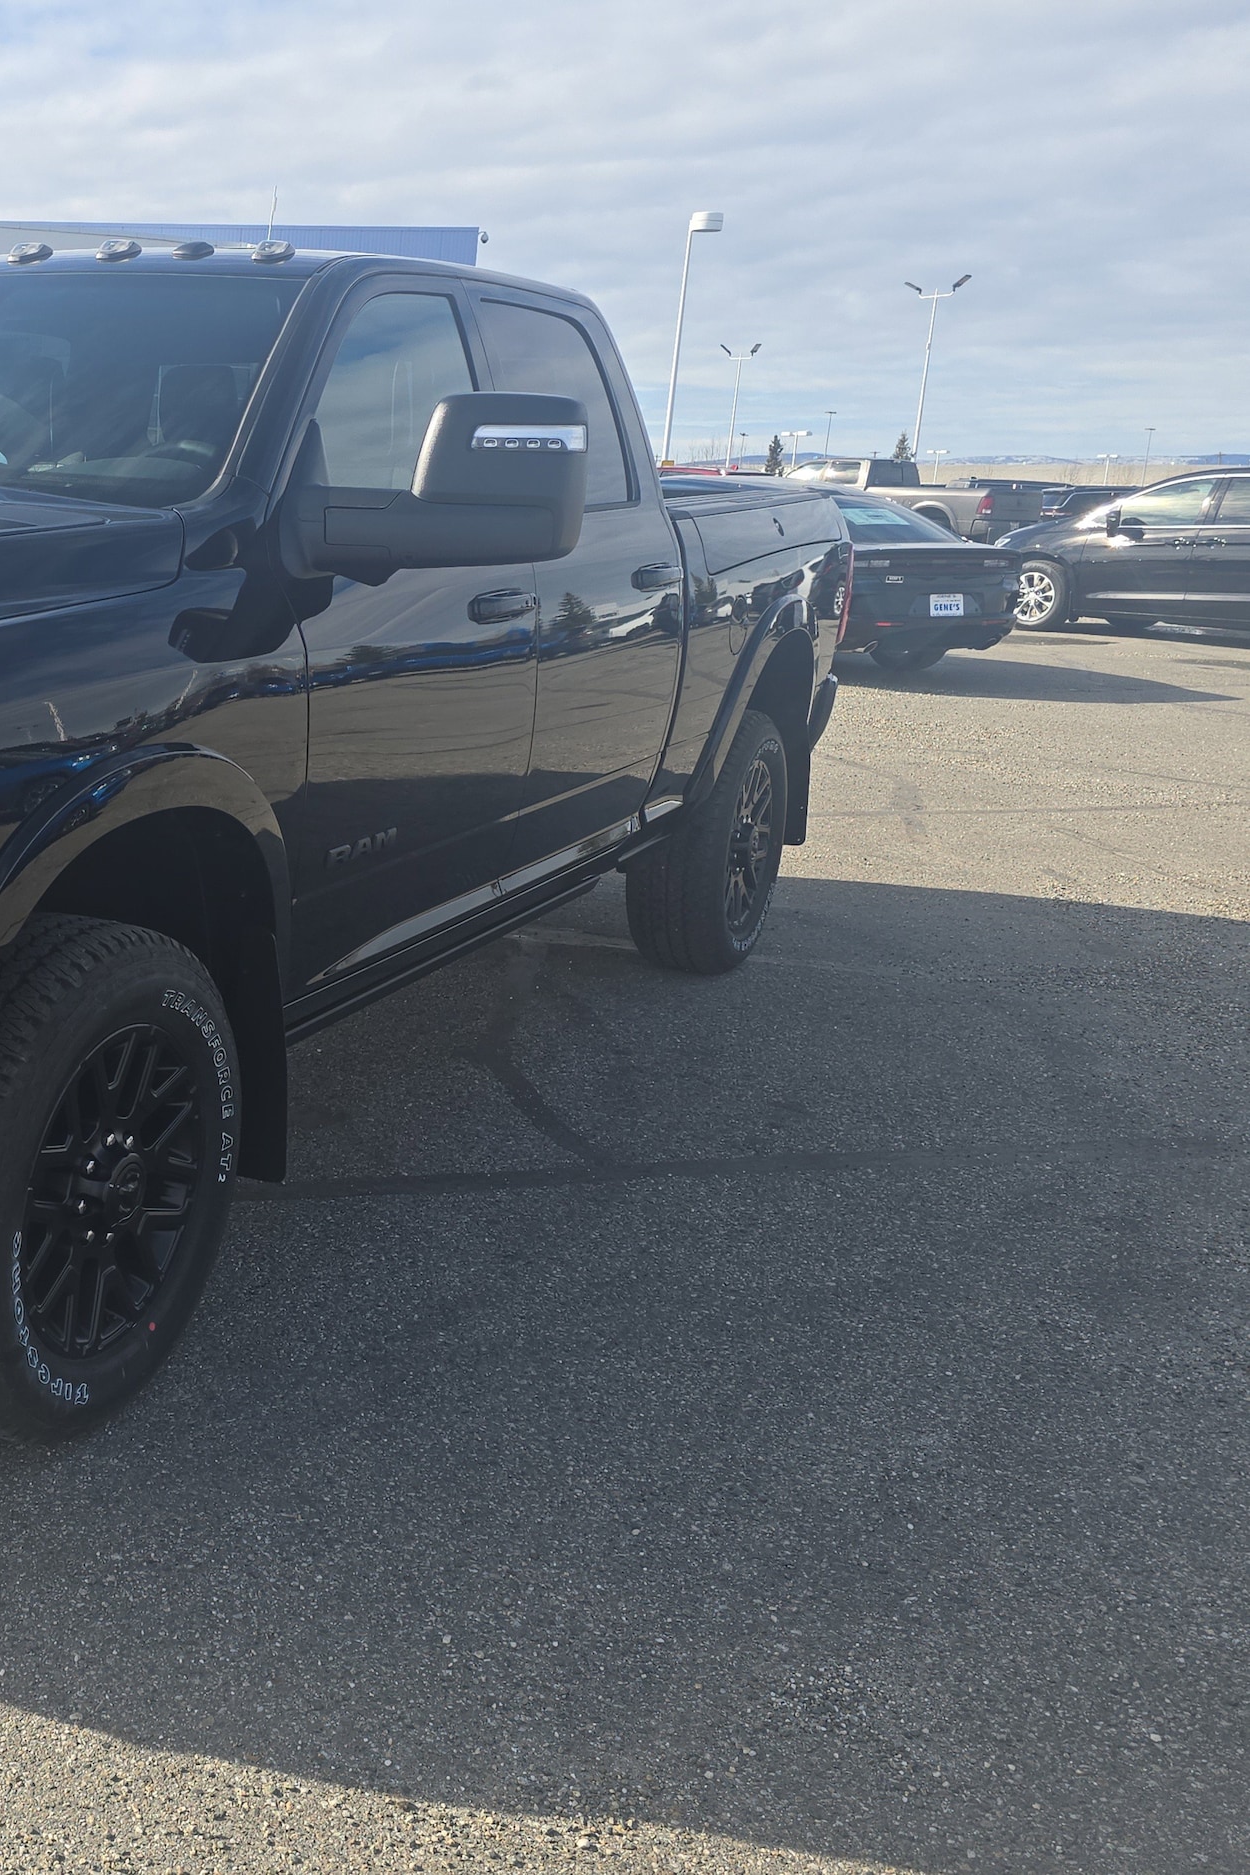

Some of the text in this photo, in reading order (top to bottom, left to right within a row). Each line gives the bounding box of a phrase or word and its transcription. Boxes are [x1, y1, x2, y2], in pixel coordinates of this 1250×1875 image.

[933, 603, 960, 611] GENE'S
[326, 826, 398, 867] RAM
[161, 989, 235, 1119] TRANSFORCE
